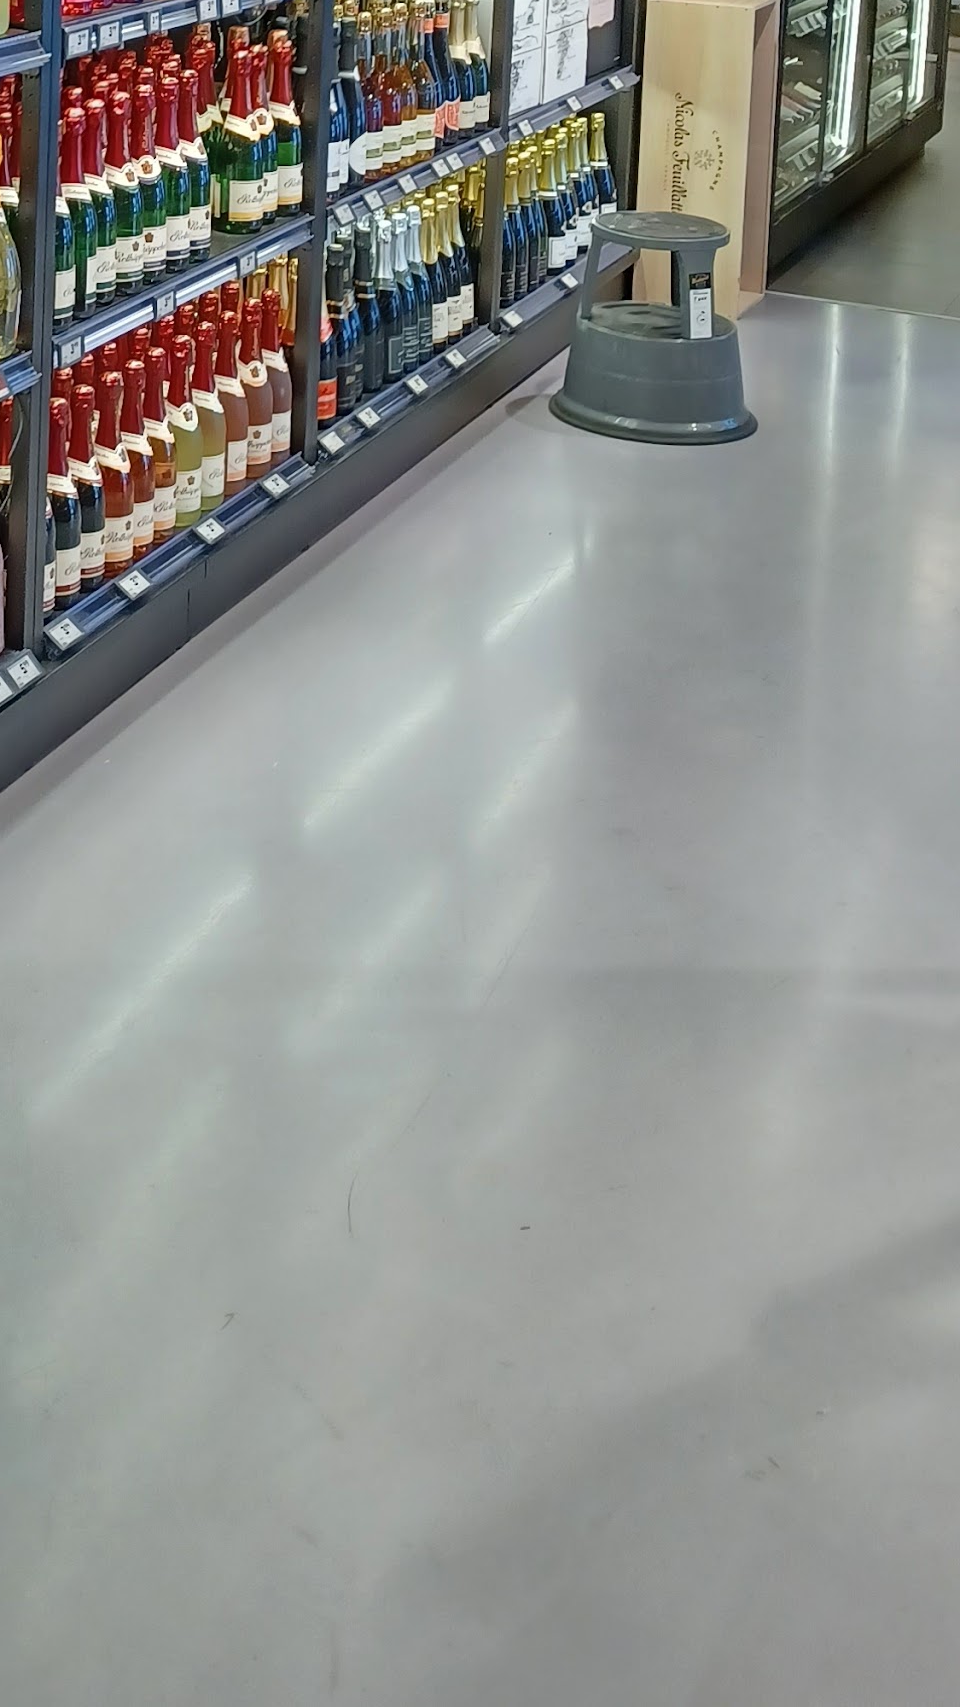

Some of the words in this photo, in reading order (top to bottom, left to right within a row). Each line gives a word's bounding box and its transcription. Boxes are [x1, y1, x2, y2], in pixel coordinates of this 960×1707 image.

[673, 91, 695, 148] Nicolas
[670, 150, 691, 213] Feuillatt
[709, 129, 725, 191] CHAMPAGNE
